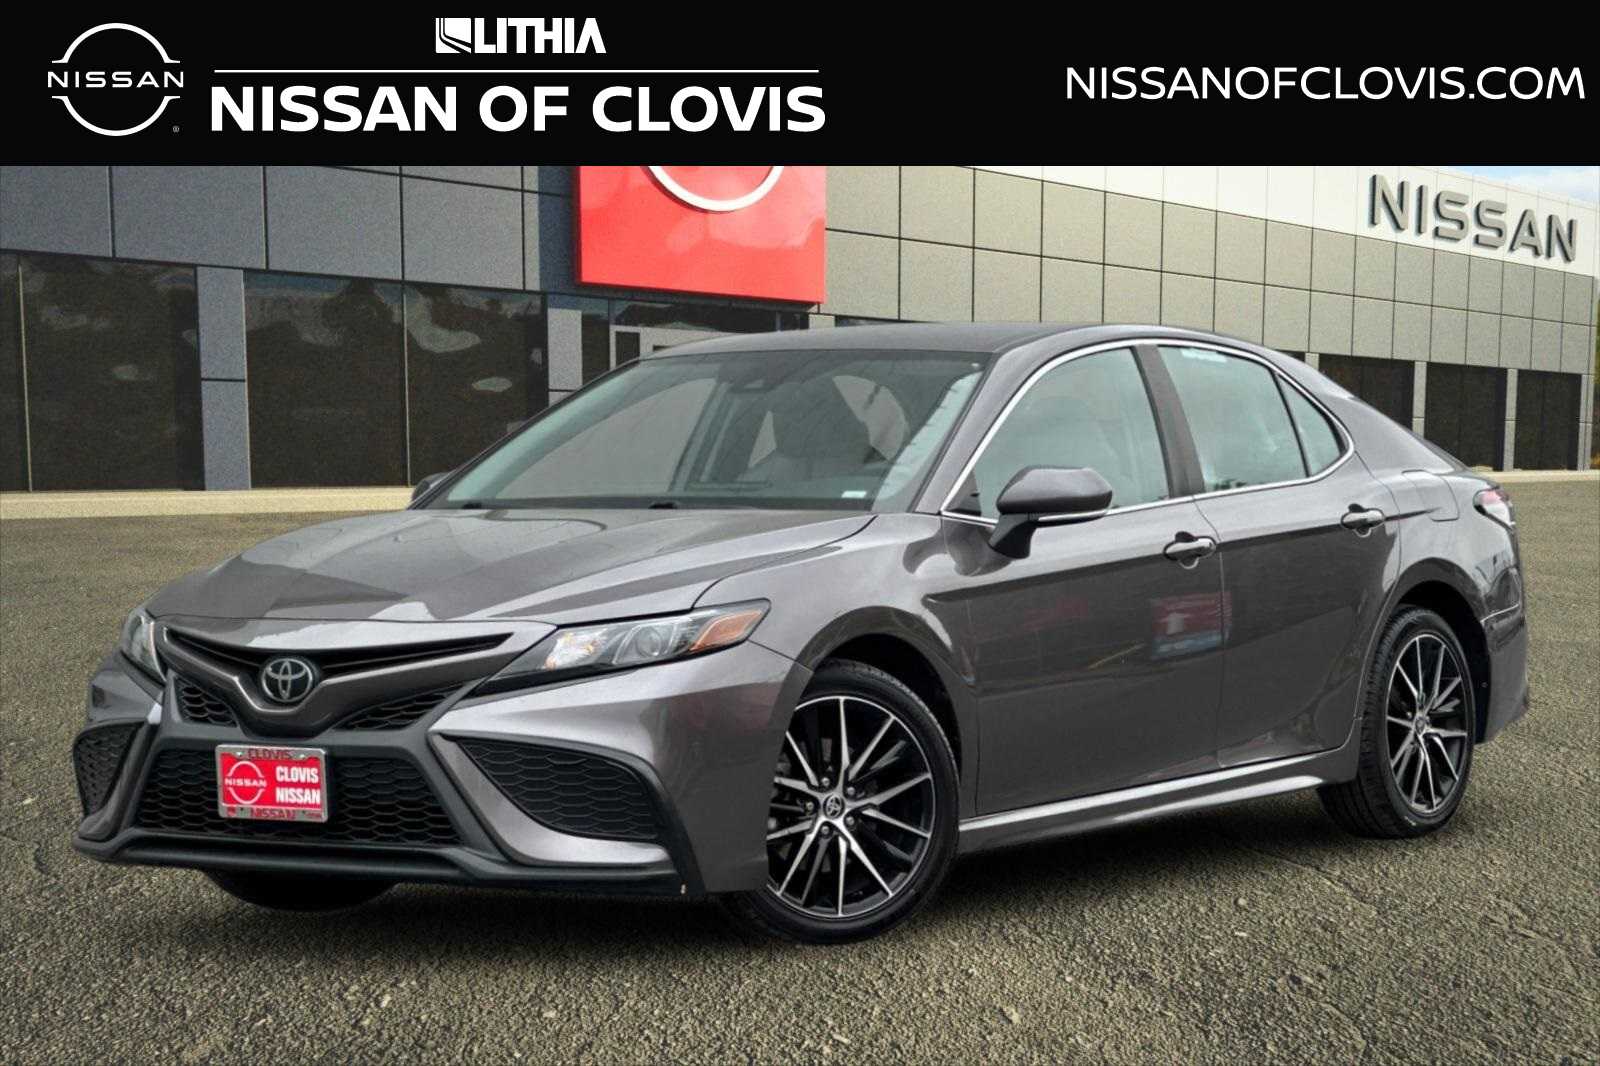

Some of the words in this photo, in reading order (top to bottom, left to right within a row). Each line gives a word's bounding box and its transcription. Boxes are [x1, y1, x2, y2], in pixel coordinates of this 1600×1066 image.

[1369, 174, 1578, 263] NISSAN
[248, 748, 293, 760] CLOVIS
[276, 766, 319, 783] CLOVIS
[224, 778, 267, 787] NISSAN
[276, 788, 321, 804] NISSAN
[251, 807, 296, 819] NISSAN
